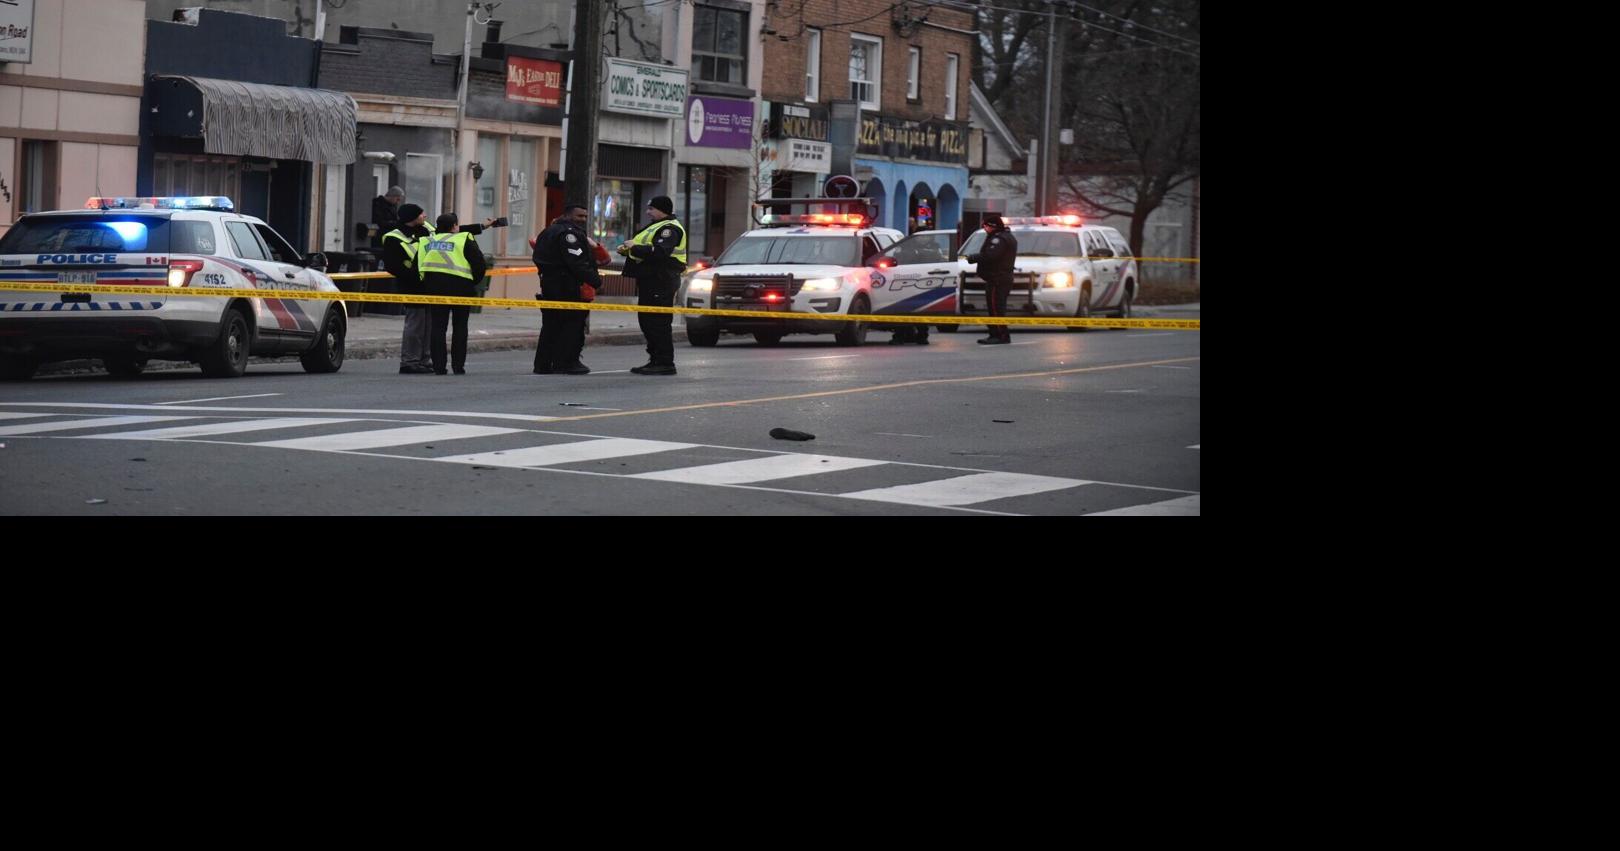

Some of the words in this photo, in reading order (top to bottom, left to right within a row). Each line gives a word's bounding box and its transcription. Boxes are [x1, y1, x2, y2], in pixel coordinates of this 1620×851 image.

[8, 24, 29, 38] Road
[545, 71, 560, 88] DELI
[611, 75, 634, 96] COMICS
[642, 79, 685, 102] SPORTSCARDS
[782, 116, 827, 141] SOCIAL
[941, 130, 965, 155] PIZZA
[36, 254, 117, 265] POLICE
